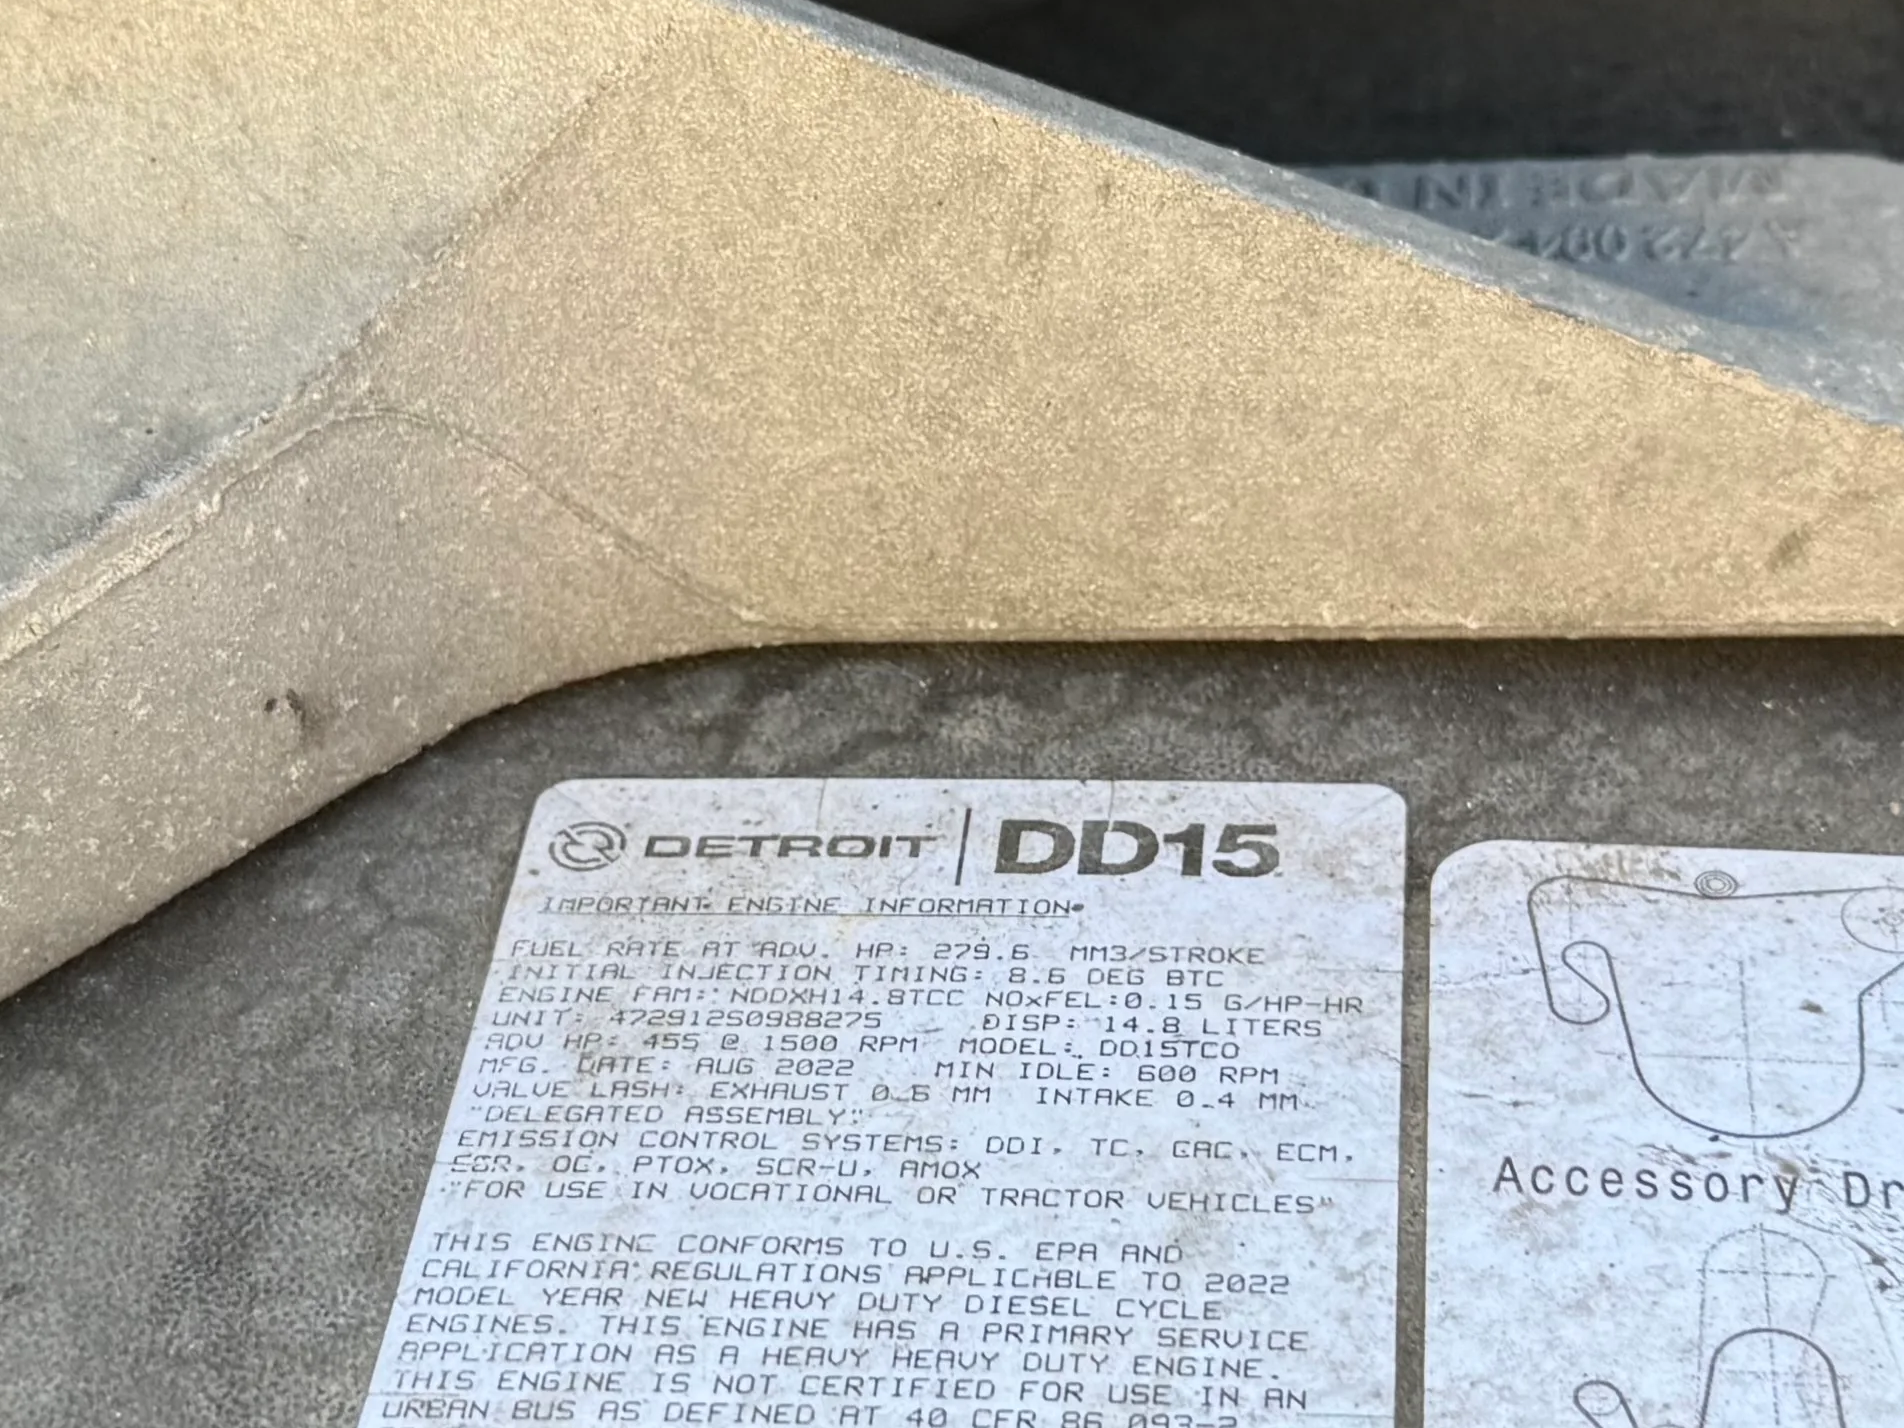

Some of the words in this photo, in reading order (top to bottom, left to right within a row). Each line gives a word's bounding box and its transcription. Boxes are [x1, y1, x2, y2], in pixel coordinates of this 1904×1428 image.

[643, 833, 939, 860] DETROIT
[994, 818, 1281, 878] DD15
[538, 896, 712, 915] IMPORTANT
[728, 896, 840, 912] ENGINE
[861, 896, 1071, 915] INFORMATION
[511, 939, 583, 958] FUEL
[606, 938, 682, 959] RATE
[701, 940, 741, 958] AT
[754, 940, 829, 959] ADV.
[855, 942, 908, 959] HP:
[933, 943, 1029, 961] 279.6
[1069, 944, 1265, 966] MM3/STROKE
[508, 963, 635, 981] INITIAL
[661, 960, 832, 982] INJECTION
[853, 964, 982, 985] TIMING:
[1008, 967, 1065, 985] 8.6
[1087, 966, 1145, 986] DEG
[1166, 969, 1224, 988] BTC
[498, 986, 613, 1003] ENGINE
[730, 987, 965, 1007] NDDXH14.8TCC
[1224, 994, 1363, 1015] G/HP-HR
[491, 1007, 583, 1027] UNIT:
[982, 1013, 1075, 1032] DISP:
[1105, 1016, 1178, 1034] 14.8
[1202, 1018, 1321, 1037] LITERS
[478, 1056, 549, 1074] MFG.
[583, 1055, 670, 1074] DATE:
[694, 1057, 755, 1075] AUG
[775, 1058, 854, 1077] 2022
[934, 1060, 995, 1079] MIN
[1019, 1062, 1110, 1081] IDLE:
[1137, 1064, 1197, 1083] 600
[1219, 1066, 1279, 1085] RPM
[545, 1181, 607, 1199] USE
[631, 1181, 668, 1200] IN
[689, 1182, 892, 1205] VOCATIONAL
[916, 1186, 957, 1205] OR
[981, 1187, 1124, 1209] TRACTOR
[1493, 1155, 1801, 1215] Accessory
[433, 1231, 511, 1252] THIS
[532, 1232, 656, 1253] ENGINE
[677, 1233, 844, 1256] CONFORMS
[869, 1237, 907, 1257] TO
[929, 1240, 1007, 1262] U.S.
[1035, 1241, 1098, 1262] EPA
[1120, 1240, 1184, 1265] AND
[421, 1259, 629, 1281] CALIFORNIA
[649, 1261, 882, 1284] REGULATIONS
[904, 1265, 1116, 1291] APPLICABLE
[1142, 1271, 1182, 1293] TO
[1205, 1273, 1290, 1296] 2022
[412, 1286, 515, 1306] MODEL
[542, 1287, 623, 1307] YEAR
[644, 1288, 708, 1309] NEW
[729, 1289, 836, 1311] HEAVY
[857, 1292, 943, 1315] DUTY
[964, 1294, 1091, 1317] DIESEL
[1115, 1298, 1222, 1321] CYCLE
[405, 1313, 568, 1335] ENGINES.
[600, 1315, 681, 1336] THIS
[702, 1316, 830, 1339] ENGINE
[853, 1319, 917, 1340] HAS
[939, 1321, 960, 1343] A
[982, 1322, 1134, 1347] PRIMARY
[1157, 1327, 1309, 1353] SERVICE
[397, 1340, 632, 1366] APPLICATION
[654, 1344, 696, 1365] AS
[718, 1345, 739, 1366] A
[761, 1346, 870, 1368] HEAVY
[891, 1346, 1000, 1373] HEAVY
[1022, 1351, 1110, 1374] DUTY
[1133, 1354, 1279, 1380] ENGINE.
[395, 1369, 476, 1391] THIS
[497, 1370, 626, 1393] ENGINE
[649, 1371, 691, 1395] IS
[712, 1373, 778, 1397] NOT
[798, 1375, 996, 1401] CERTIFIED
[1019, 1380, 1084, 1403] FOR
[1107, 1383, 1172, 1406] USE
[1195, 1387, 1246, 1408] IN
[1263, 1388, 1307, 1410] AN
[382, 1398, 490, 1420] URBAN
[511, 1399, 576, 1422] BUS
[598, 1400, 641, 1421] AS
[663, 1402, 816, 1426] DEFINED
[839, 1405, 882, 1426] AT
[905, 1407, 948, 1428] 40
